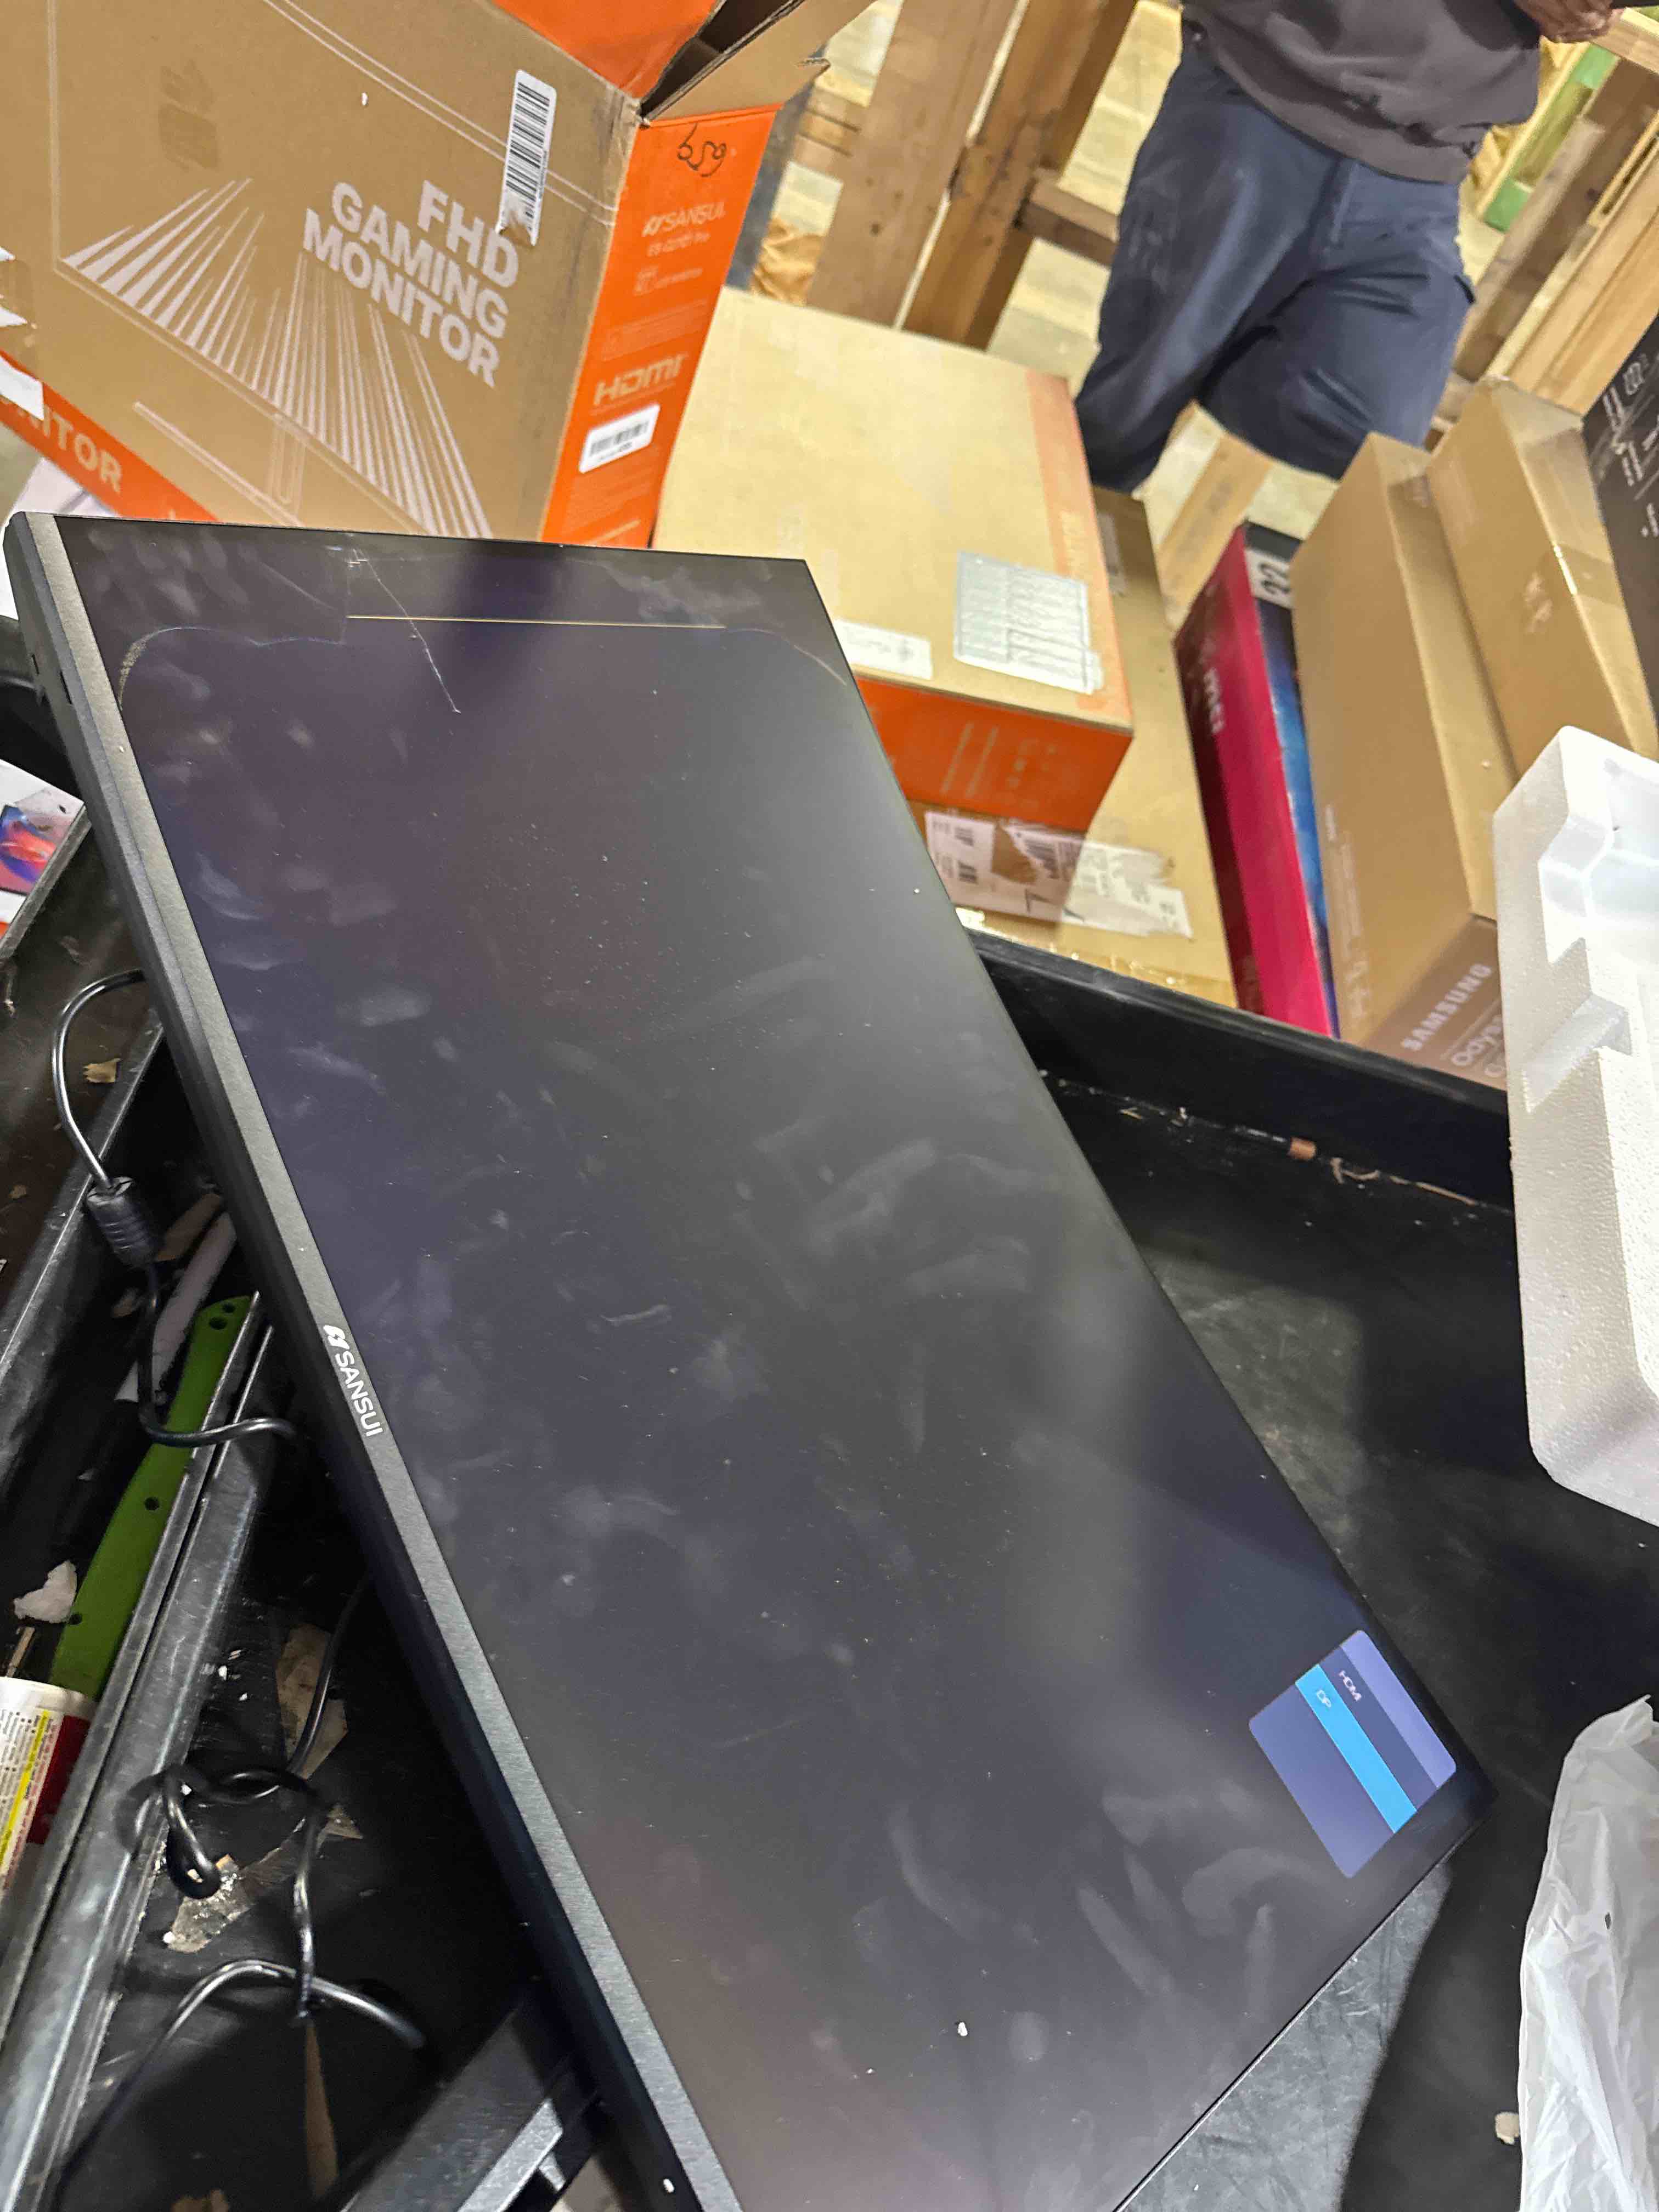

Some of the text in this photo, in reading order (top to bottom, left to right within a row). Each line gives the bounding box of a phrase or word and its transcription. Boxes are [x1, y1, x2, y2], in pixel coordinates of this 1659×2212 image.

[332, 182, 509, 338] GAMING
[417, 179, 518, 288] FHD
[303, 207, 500, 389] MONITOR
[592, 353, 687, 407] HDMI
[1402, 963, 1493, 1052] SAMSUNG
[335, 1350, 383, 1437] SANSUI
[1316, 1689, 1331, 1708] DP
[1338, 1670, 1362, 1702] HDMI
